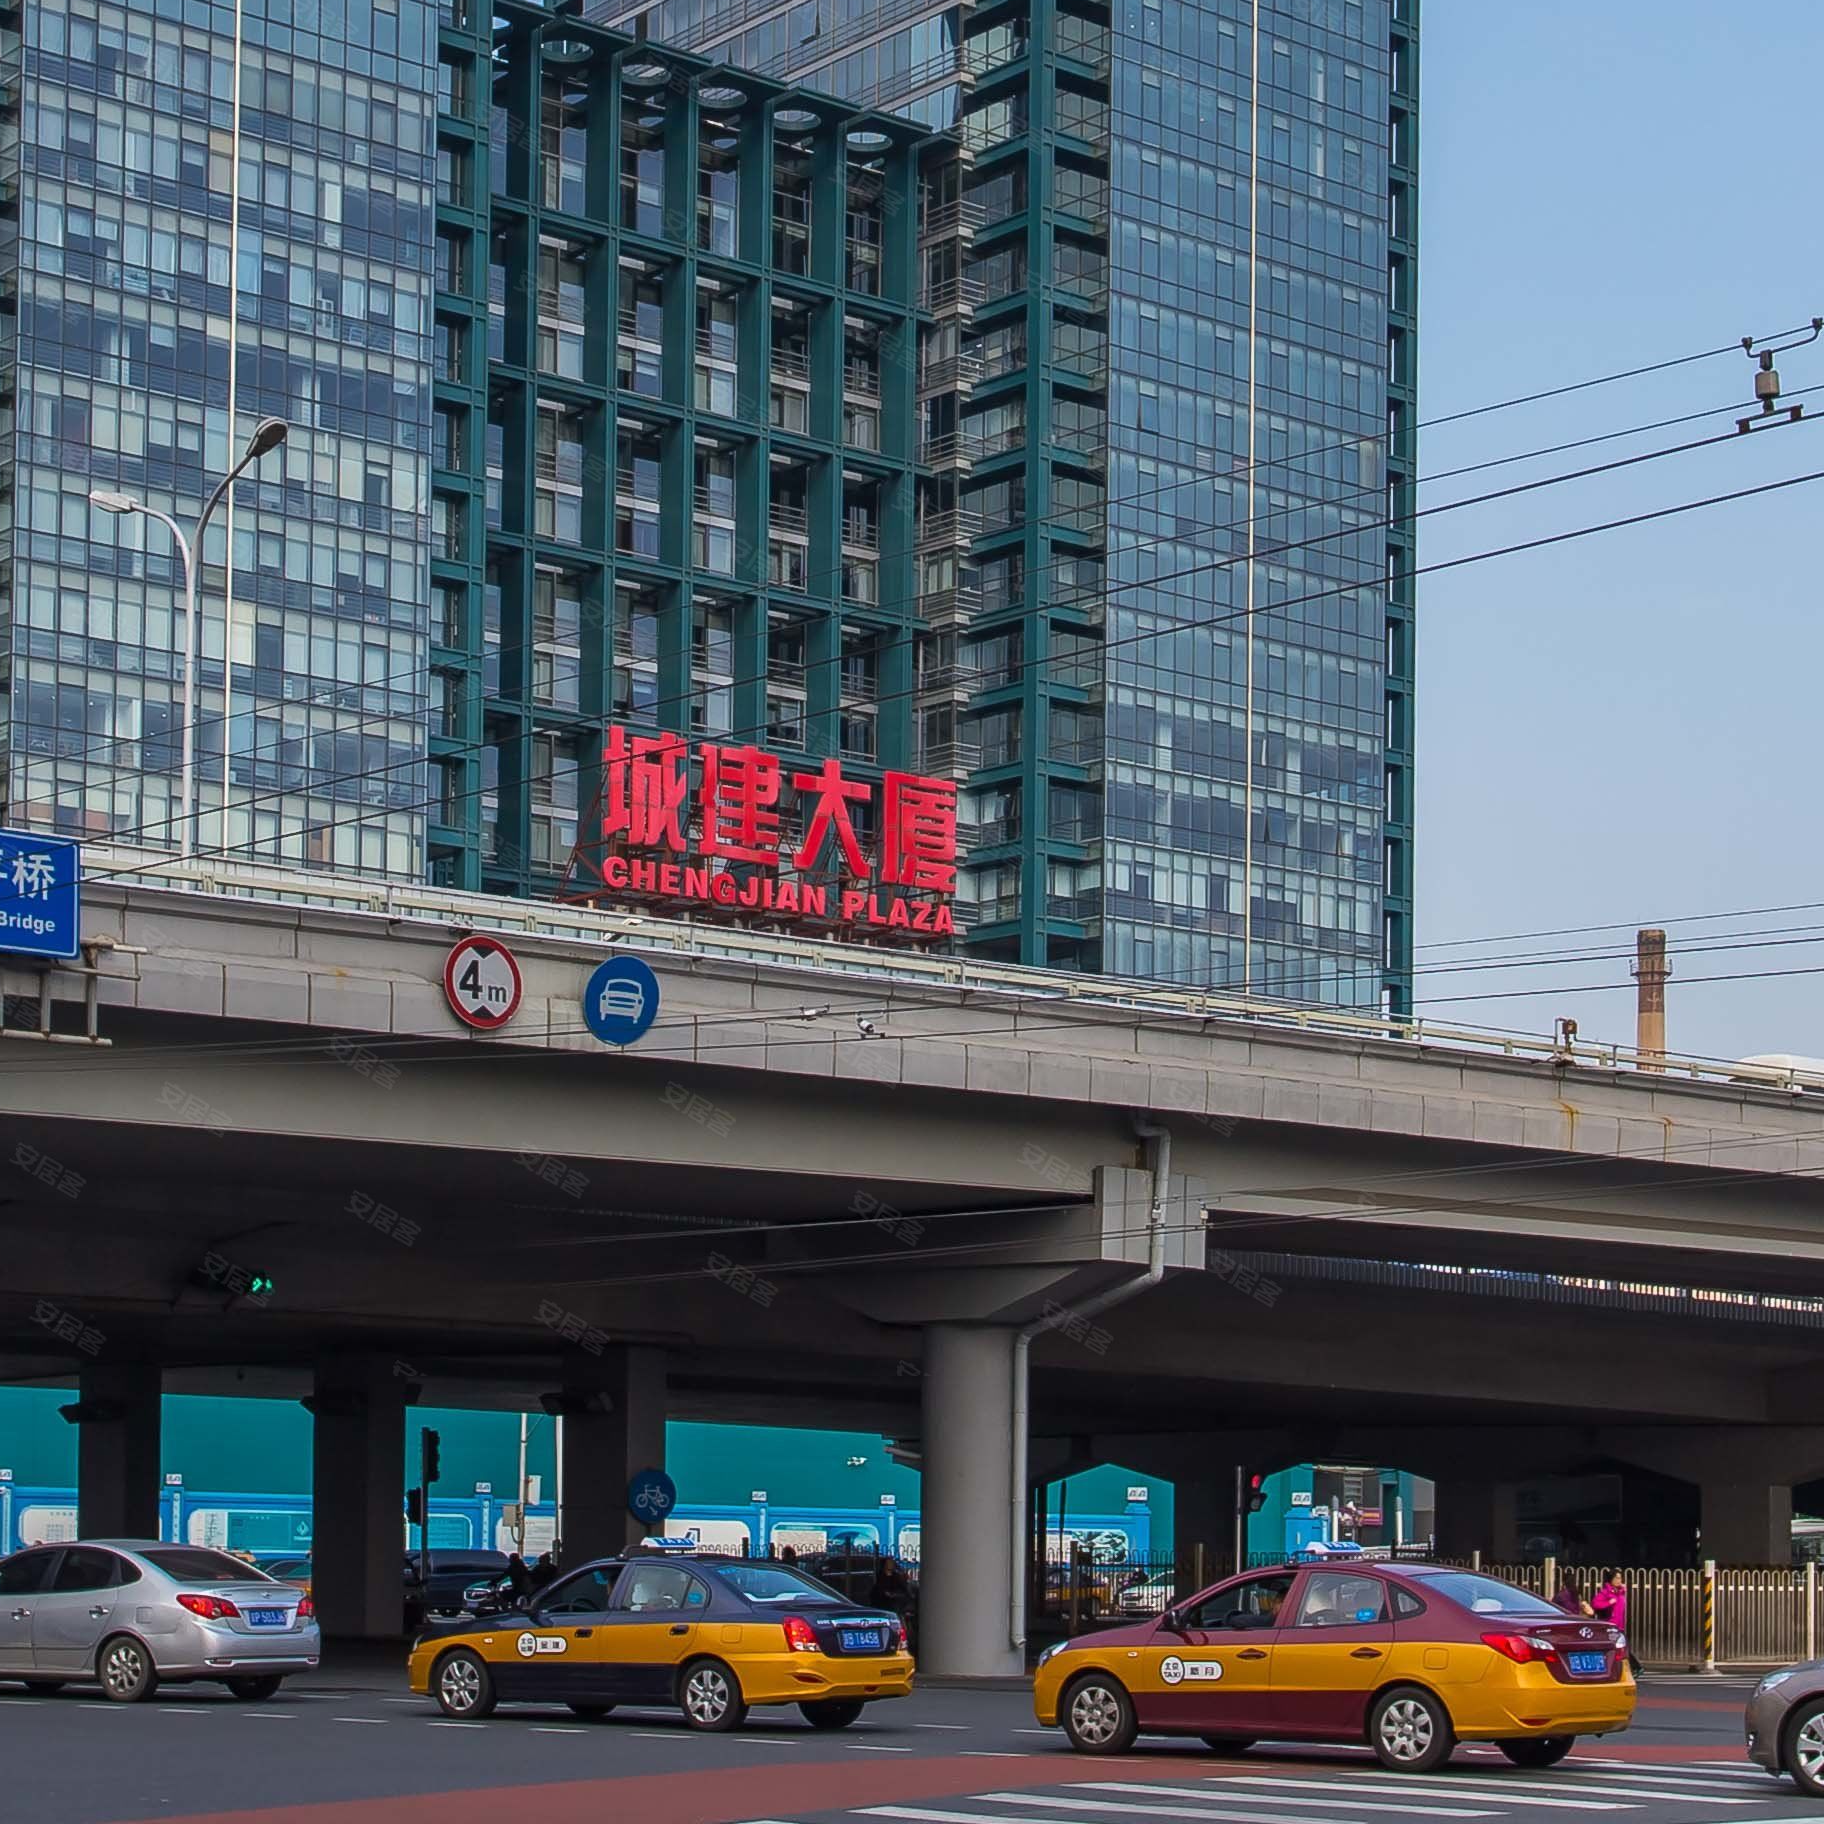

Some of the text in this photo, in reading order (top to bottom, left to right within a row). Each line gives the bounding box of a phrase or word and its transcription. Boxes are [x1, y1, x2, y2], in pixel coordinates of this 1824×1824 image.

[602, 725, 957, 893] 城建大厦
[602, 856, 954, 935] CHENGJIAN PLAZA
